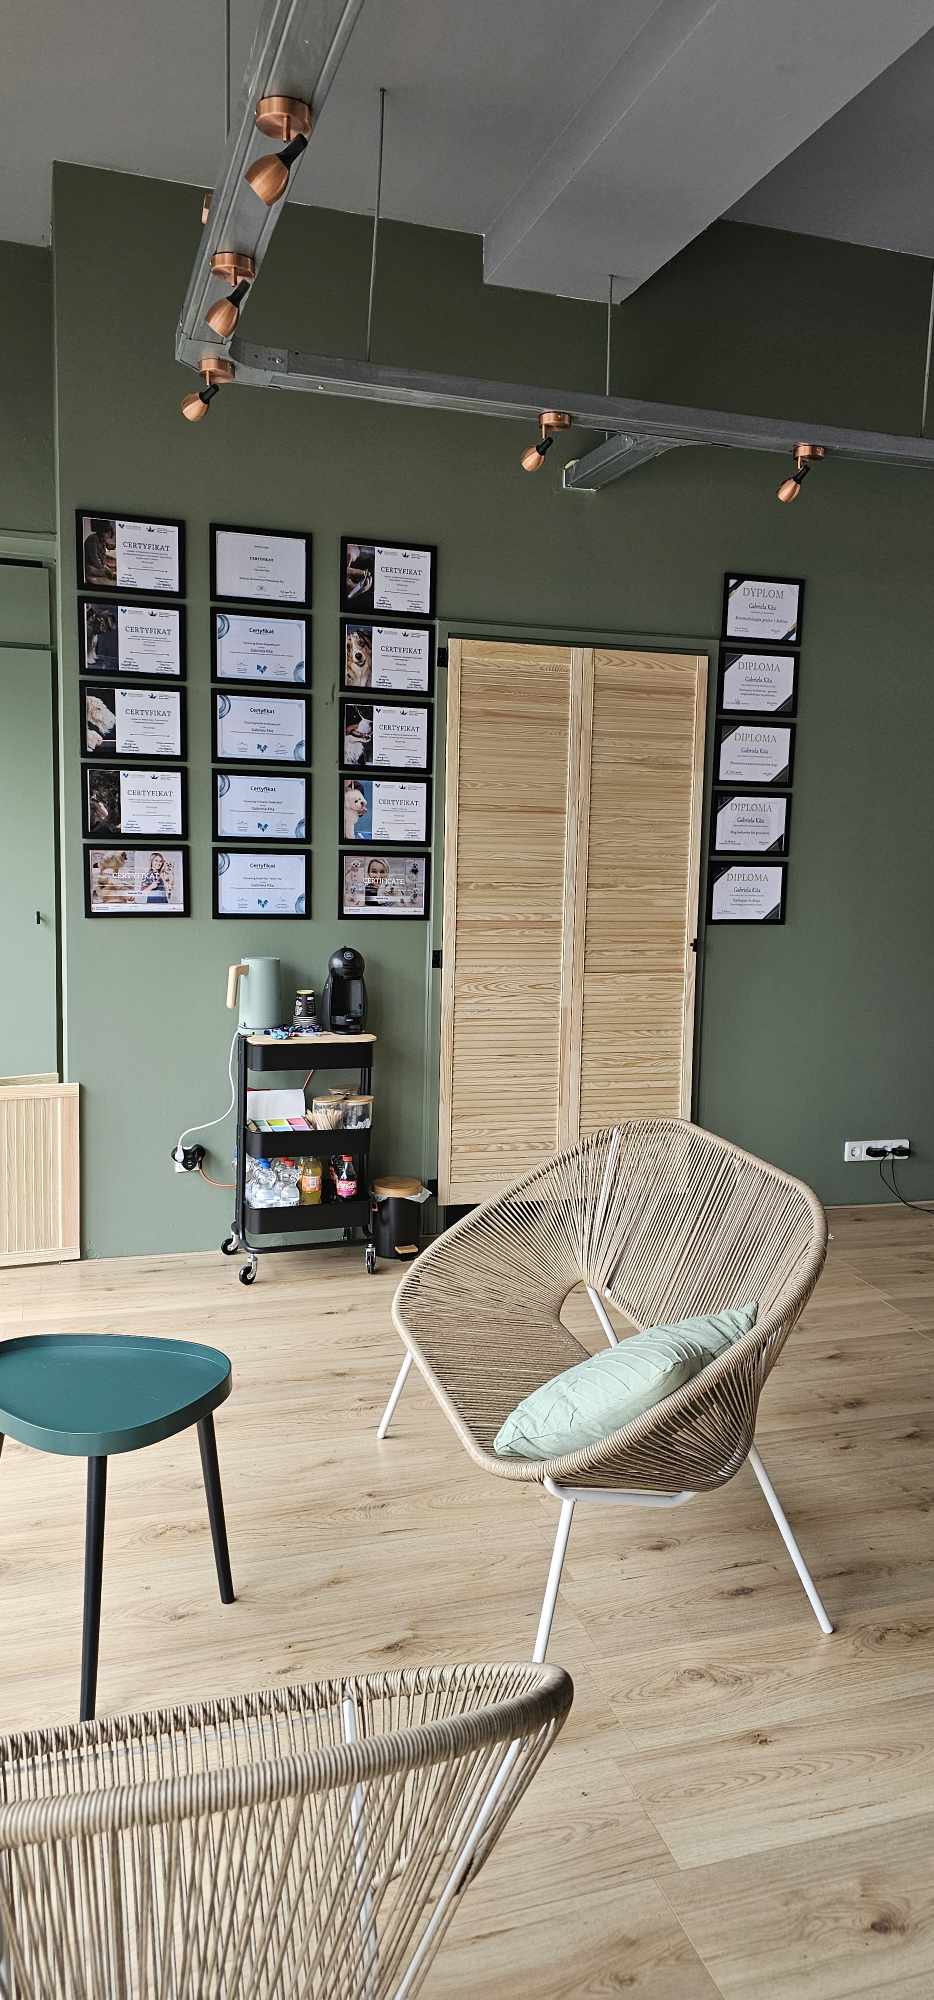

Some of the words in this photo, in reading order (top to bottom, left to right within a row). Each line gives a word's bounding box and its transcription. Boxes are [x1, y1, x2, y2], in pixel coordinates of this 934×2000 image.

[122, 541, 170, 552] CERTYFIKAT
[380, 566, 423, 576] CERTYFIKAT
[742, 587, 785, 600] DYPLOM
[125, 626, 172, 636] CERTYFIKAT
[249, 627, 274, 635] Certyfikat
[380, 645, 423, 655] CERTYFIKAT
[738, 661, 781, 673] DIPLOMA
[125, 708, 172, 717] CERTYFIKAT
[249, 707, 275, 715] Certyfikat
[378, 724, 420, 733] CERTYFIKAT
[734, 732, 777, 743] DIPLOMA
[127, 789, 174, 797] CERTYFIKAT
[378, 798, 419, 806] CERTYFIKAT
[730, 802, 772, 812] DIPLOMA
[363, 877, 405, 886] CERTIFICATE
[726, 873, 769, 882] DIPLOMA
